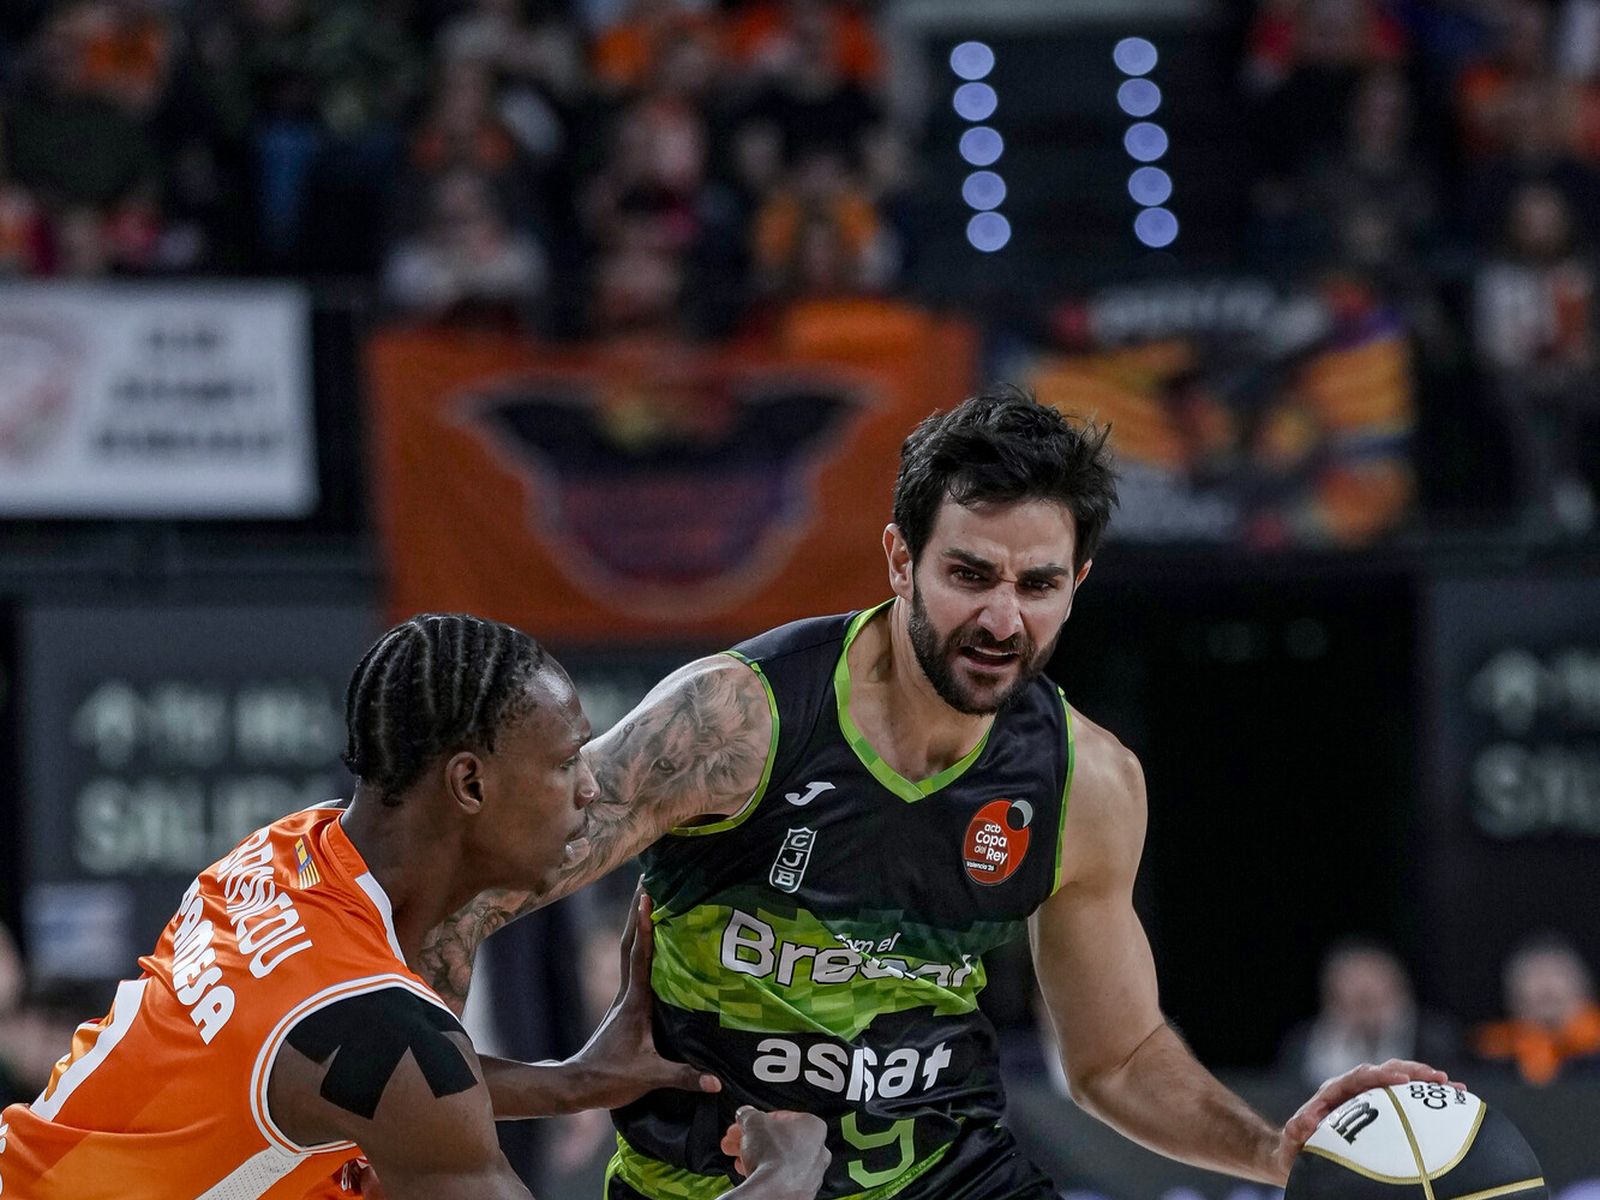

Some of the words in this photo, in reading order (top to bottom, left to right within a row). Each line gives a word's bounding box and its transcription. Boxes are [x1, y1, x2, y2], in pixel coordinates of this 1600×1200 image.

[984, 823, 1001, 833] acb
[975, 830, 1008, 847] Copa
[986, 848, 1008, 865] Rey
